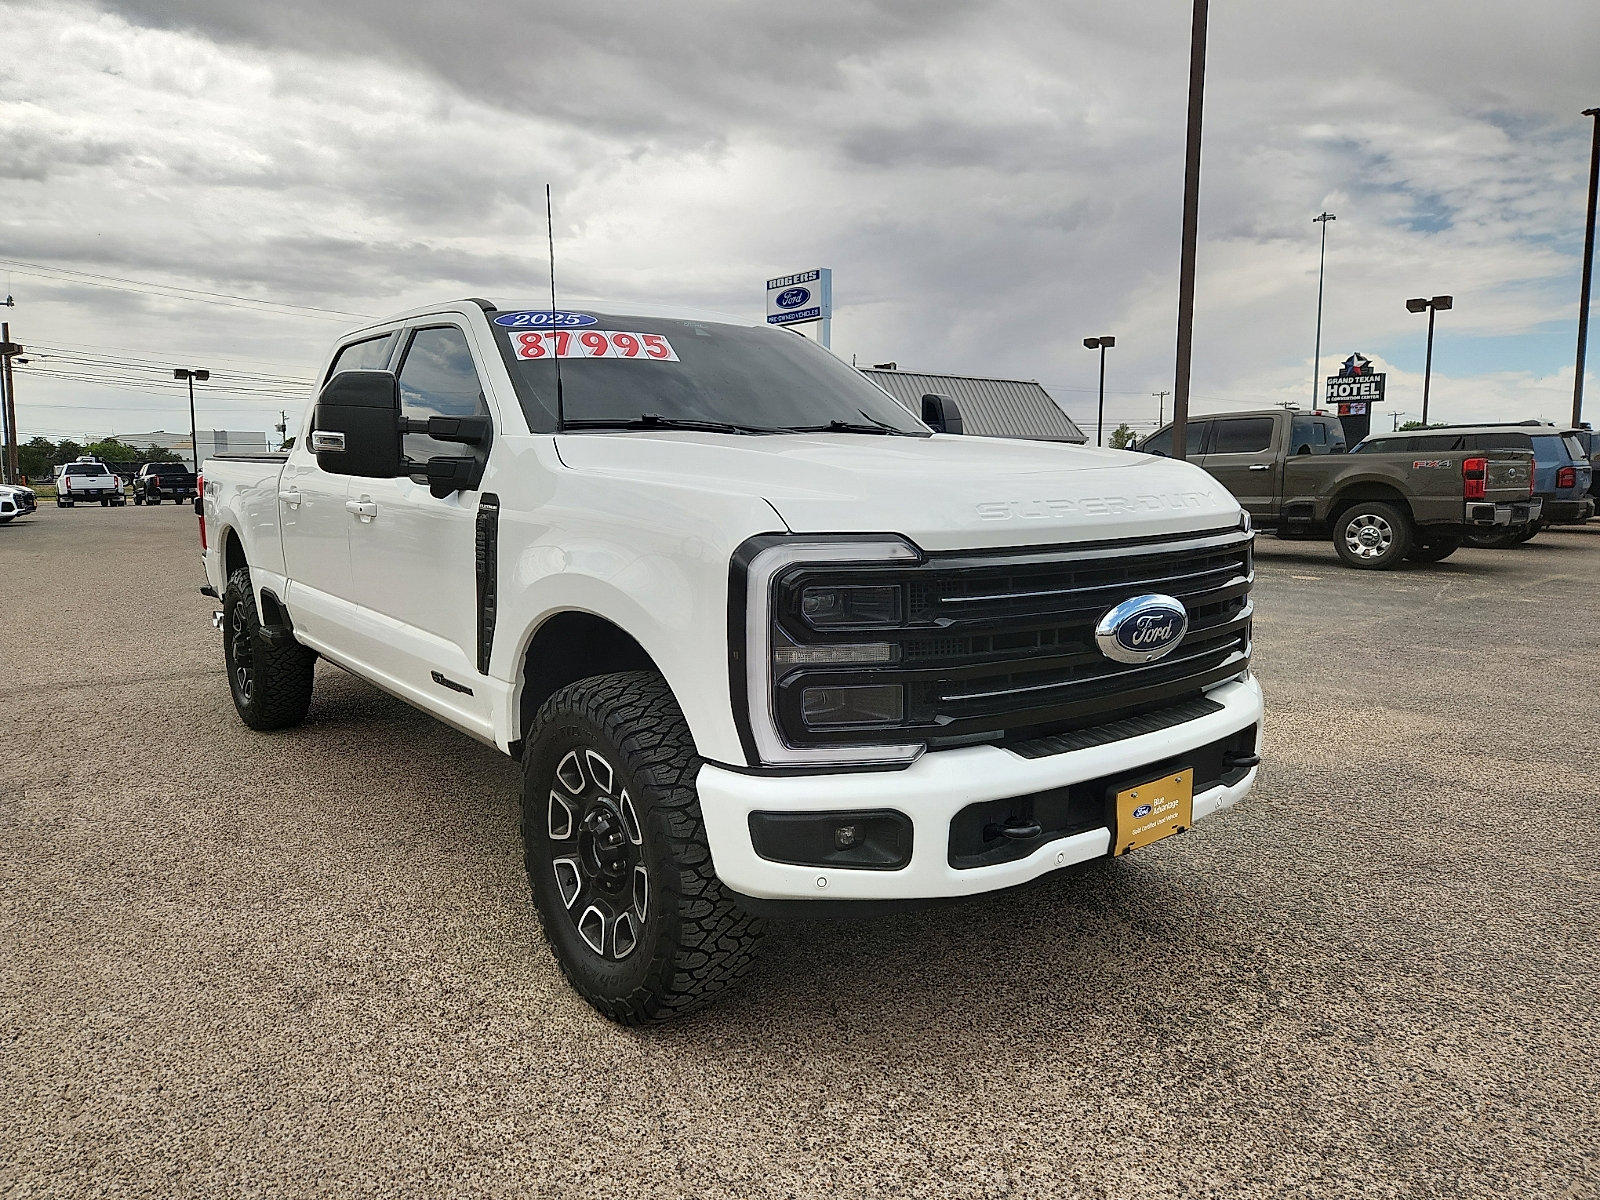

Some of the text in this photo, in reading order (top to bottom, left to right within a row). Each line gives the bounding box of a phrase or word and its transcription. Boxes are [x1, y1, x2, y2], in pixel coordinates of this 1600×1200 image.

[768, 272, 816, 288] ROGERS
[782, 290, 802, 306] Ford
[515, 314, 580, 326] 2025
[796, 309, 818, 318] VEHICLES
[516, 332, 671, 359] 87995
[1327, 383, 1380, 396] HOTEL
[1413, 460, 1452, 470] FX4
[976, 492, 1218, 521] SUPER DUTY
[1132, 614, 1174, 646] Ford
[1152, 800, 1179, 816] Advantage
[1154, 796, 1165, 806] Blue
[1166, 812, 1178, 822] Vehicle
